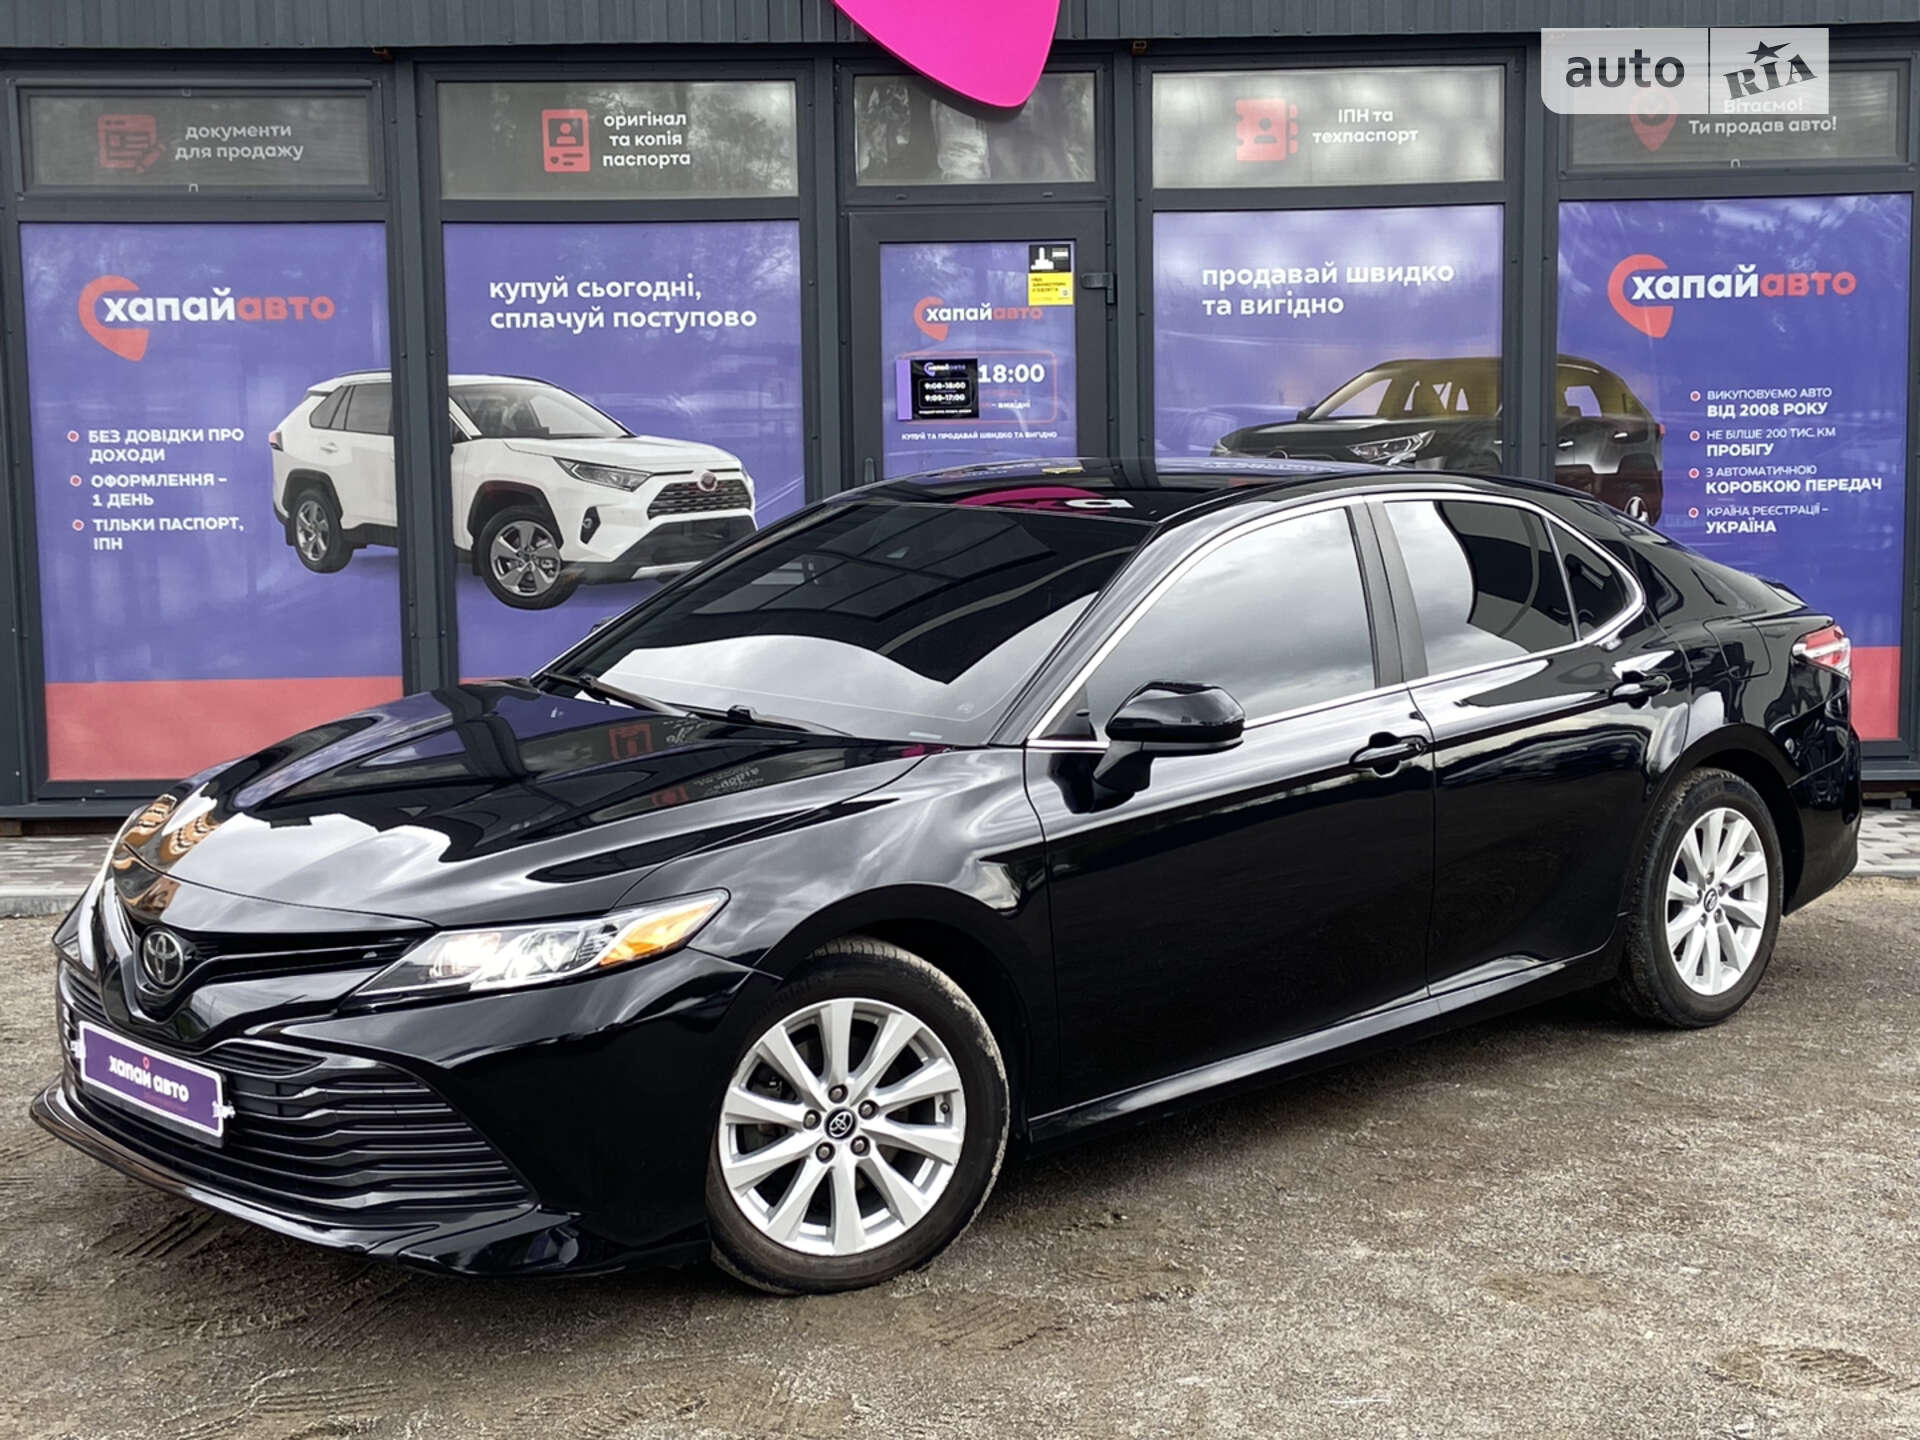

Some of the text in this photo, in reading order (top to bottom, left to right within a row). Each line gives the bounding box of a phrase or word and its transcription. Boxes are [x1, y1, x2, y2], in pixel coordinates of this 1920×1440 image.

[603, 112, 687, 128] оригінал
[1338, 109, 1393, 123] ІПН та
[185, 123, 292, 140] документи
[1689, 117, 1837, 137] Ти продав авто!
[609, 131, 682, 147] та копія
[1312, 129, 1418, 144] техпаспорт
[175, 144, 304, 160] для продажу
[602, 153, 691, 169] паспорта
[1202, 262, 1454, 291] продавай швидко
[1631, 264, 1856, 299] хапайавто
[489, 273, 702, 304] купуй сьогодні,
[103, 287, 335, 322] хапайавто
[1202, 291, 1344, 318] та вигідно
[490, 306, 757, 333] сплачуй поступово
[1706, 387, 1832, 400] ВИКУПОВУЄМО АВТО
[1706, 402, 1828, 419] ВІД 2008 РОКУ
[89, 428, 244, 444] БЕЗ ДОВІДКИ ПРО
[1706, 430, 1723, 440] НЕ
[1766, 428, 1788, 438] 200
[1817, 427, 1836, 437] КМ
[89, 449, 165, 464] ДОХОДИ
[1706, 443, 1774, 456] ПРОБІГУ
[1716, 465, 1818, 477] АВТОМАТИЧНОЮ
[91, 474, 214, 488] ОФОРМЛЕННЯ
[1706, 477, 1882, 494] КОРОБКОЮ ПЕРЕДАЧ
[92, 494, 154, 508] 1 ДЕНЬ
[1706, 505, 1750, 516] КРАЇНА
[1752, 503, 1821, 516] РЕЄСТРАЦІЇ
[92, 516, 244, 531] ТІЛЬКИ ПАСПОРТ,
[1706, 517, 1776, 534] УКРАЇНА
[94, 538, 123, 550] ІПН
[153, 1074, 189, 1103] авто
